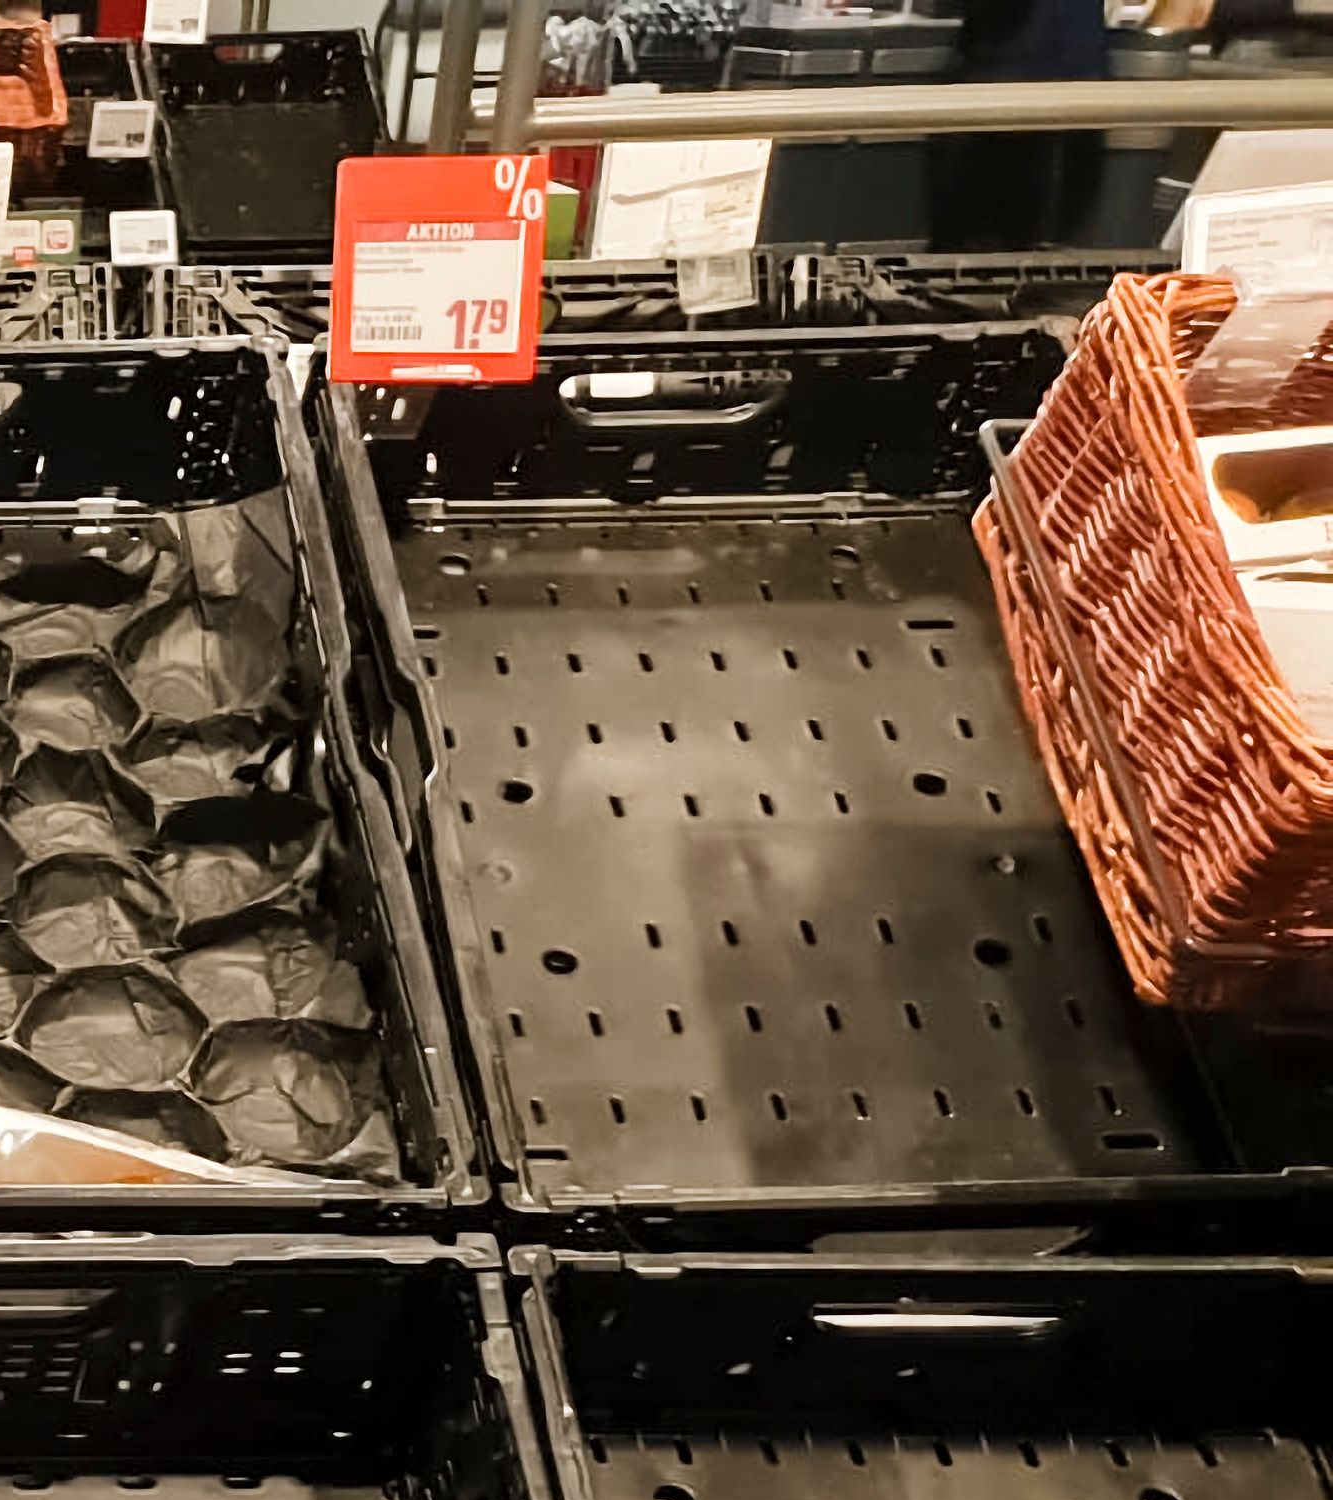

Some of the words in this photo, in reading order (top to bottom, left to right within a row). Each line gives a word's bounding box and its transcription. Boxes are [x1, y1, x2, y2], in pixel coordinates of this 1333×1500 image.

[494, 157, 542, 220] %
[406, 223, 475, 240] AKTION
[445, 299, 508, 349] 1.79
